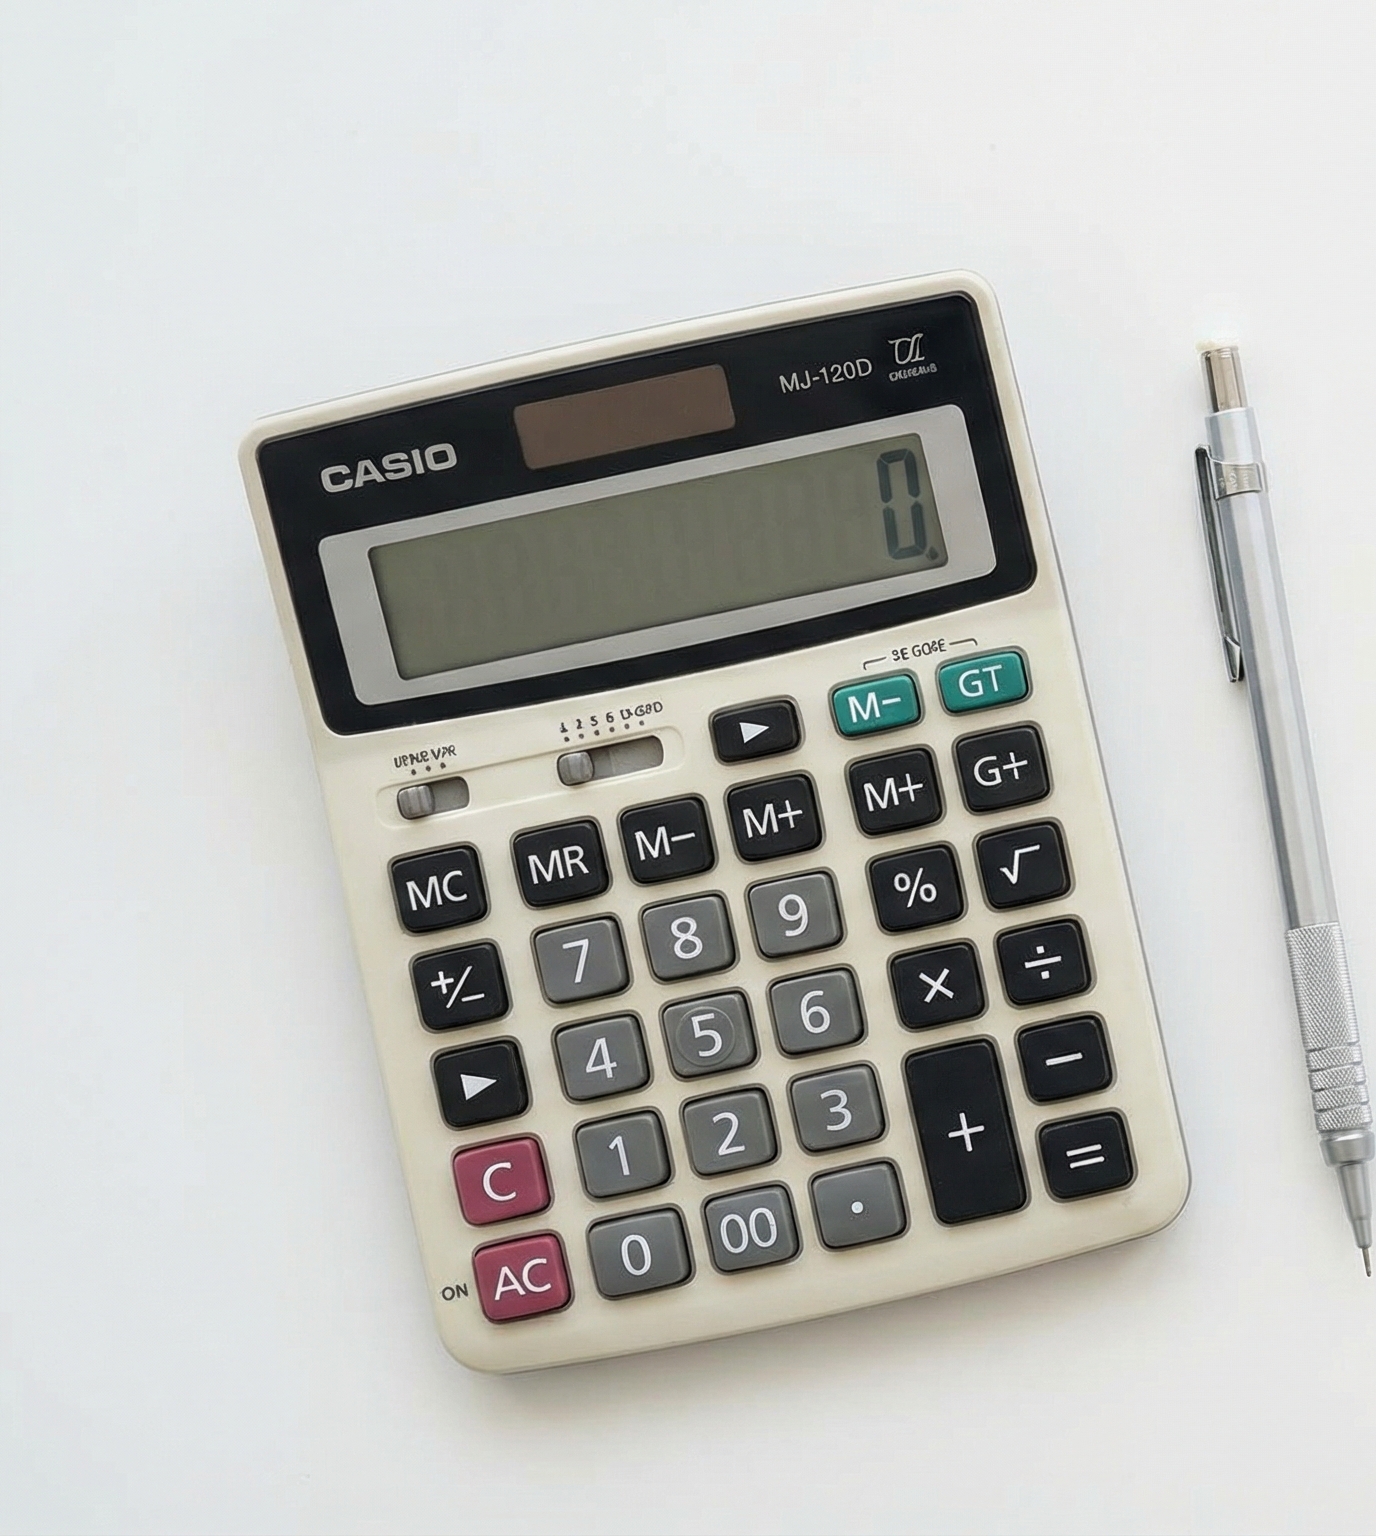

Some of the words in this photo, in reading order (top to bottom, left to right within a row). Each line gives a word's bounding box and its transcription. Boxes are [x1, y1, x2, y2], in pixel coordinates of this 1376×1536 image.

[779, 358, 873, 394] MJ-120D
[320, 442, 458, 493] CASIO
[958, 664, 1002, 697] GT
[606, 712, 614, 723] 6
[973, 752, 1028, 787] G+
[863, 773, 924, 811] M+
[743, 800, 803, 839] M+
[528, 845, 589, 884] MR
[406, 870, 467, 911] MC
[893, 867, 937, 908] %
[778, 893, 808, 937] 9
[670, 917, 703, 960] 8
[562, 938, 589, 983] 7
[800, 990, 830, 1034] 6
[691, 1013, 723, 1057] 5
[585, 1037, 617, 1079] 4
[819, 1089, 853, 1131] 3
[712, 1112, 745, 1157] 2
[608, 1135, 630, 1176] 1
[482, 1161, 516, 1201] C
[720, 1206, 778, 1254] 00
[621, 1234, 651, 1276] 0
[441, 1282, 469, 1302] ON
[494, 1257, 552, 1301] AC
